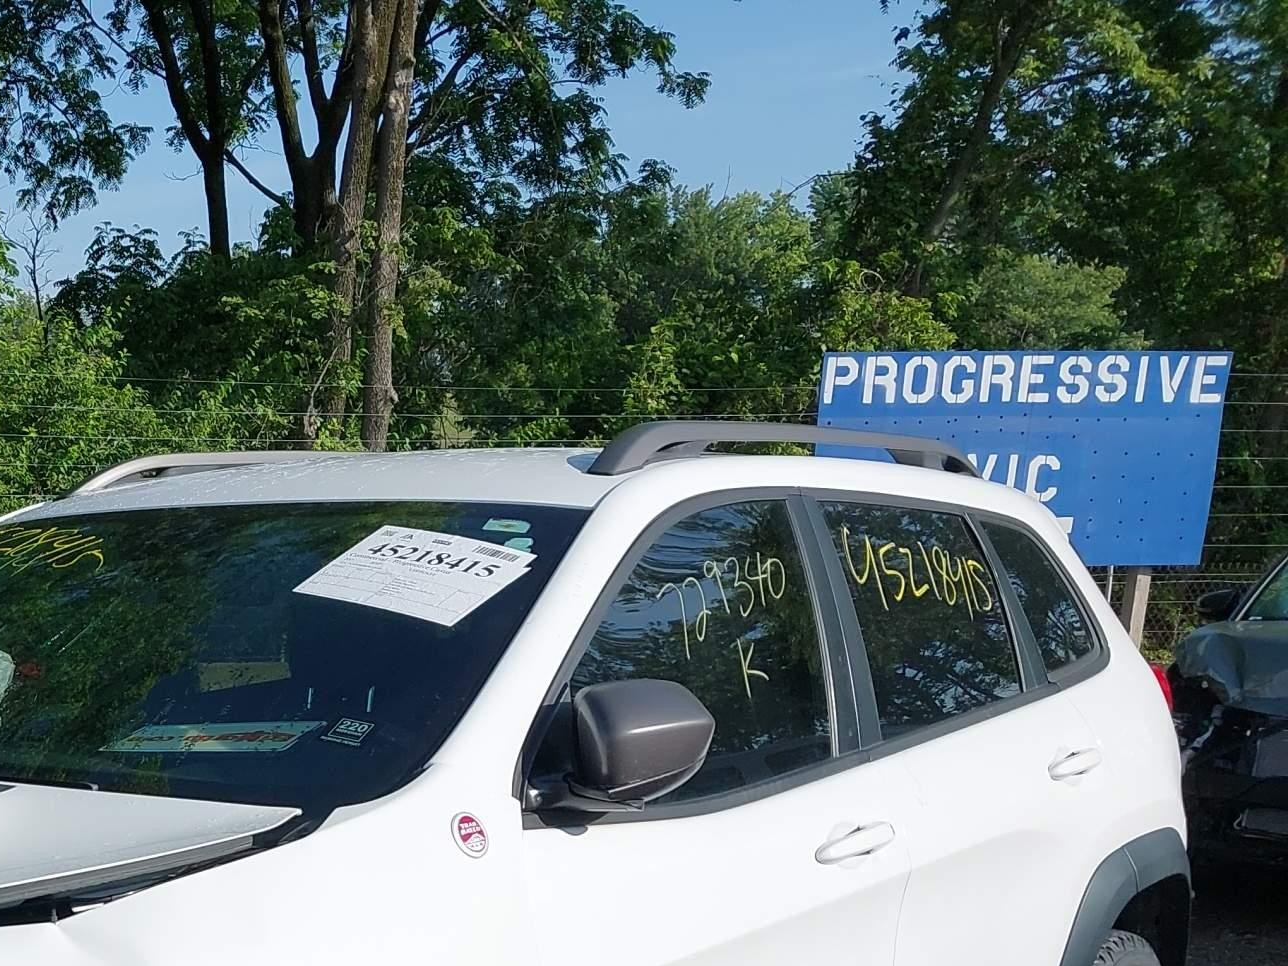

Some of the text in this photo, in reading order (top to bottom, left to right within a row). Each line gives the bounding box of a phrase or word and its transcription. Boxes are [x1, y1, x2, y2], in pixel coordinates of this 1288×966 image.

[823, 355, 1229, 404] PROGRESSIVE
[367, 542, 502, 578] 45218415
[841, 526, 993, 620] 45218415
[657, 551, 786, 660] 729340
[736, 638, 770, 699] K
[338, 720, 369, 732] 220
